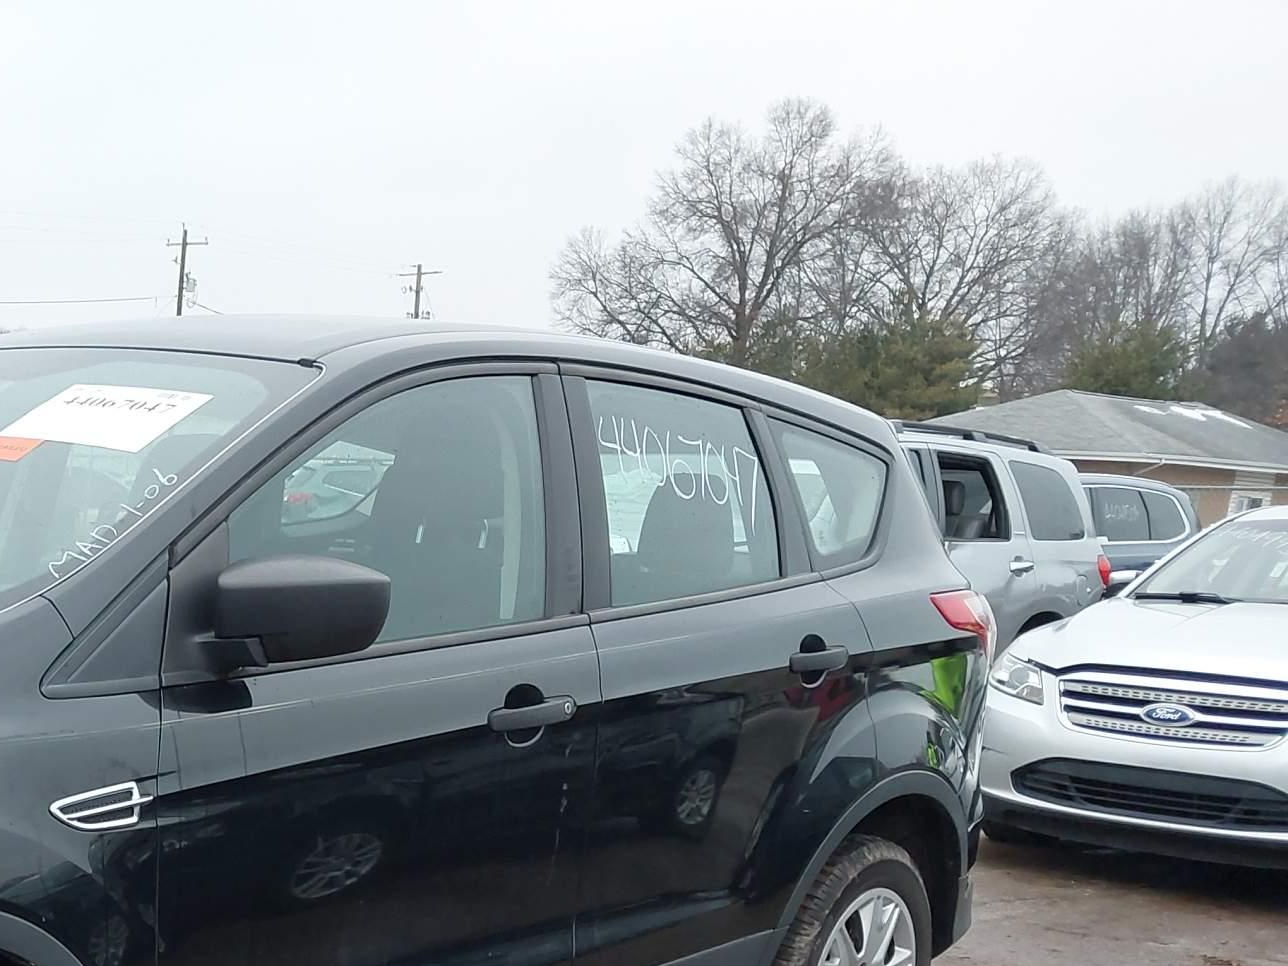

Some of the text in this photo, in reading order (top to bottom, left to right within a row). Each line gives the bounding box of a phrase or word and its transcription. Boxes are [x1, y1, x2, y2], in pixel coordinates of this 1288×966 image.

[64, 395, 178, 414] 44067047
[598, 415, 759, 537] 44067047
[48, 524, 118, 579] MAD
[1152, 708, 1182, 720] Ford
